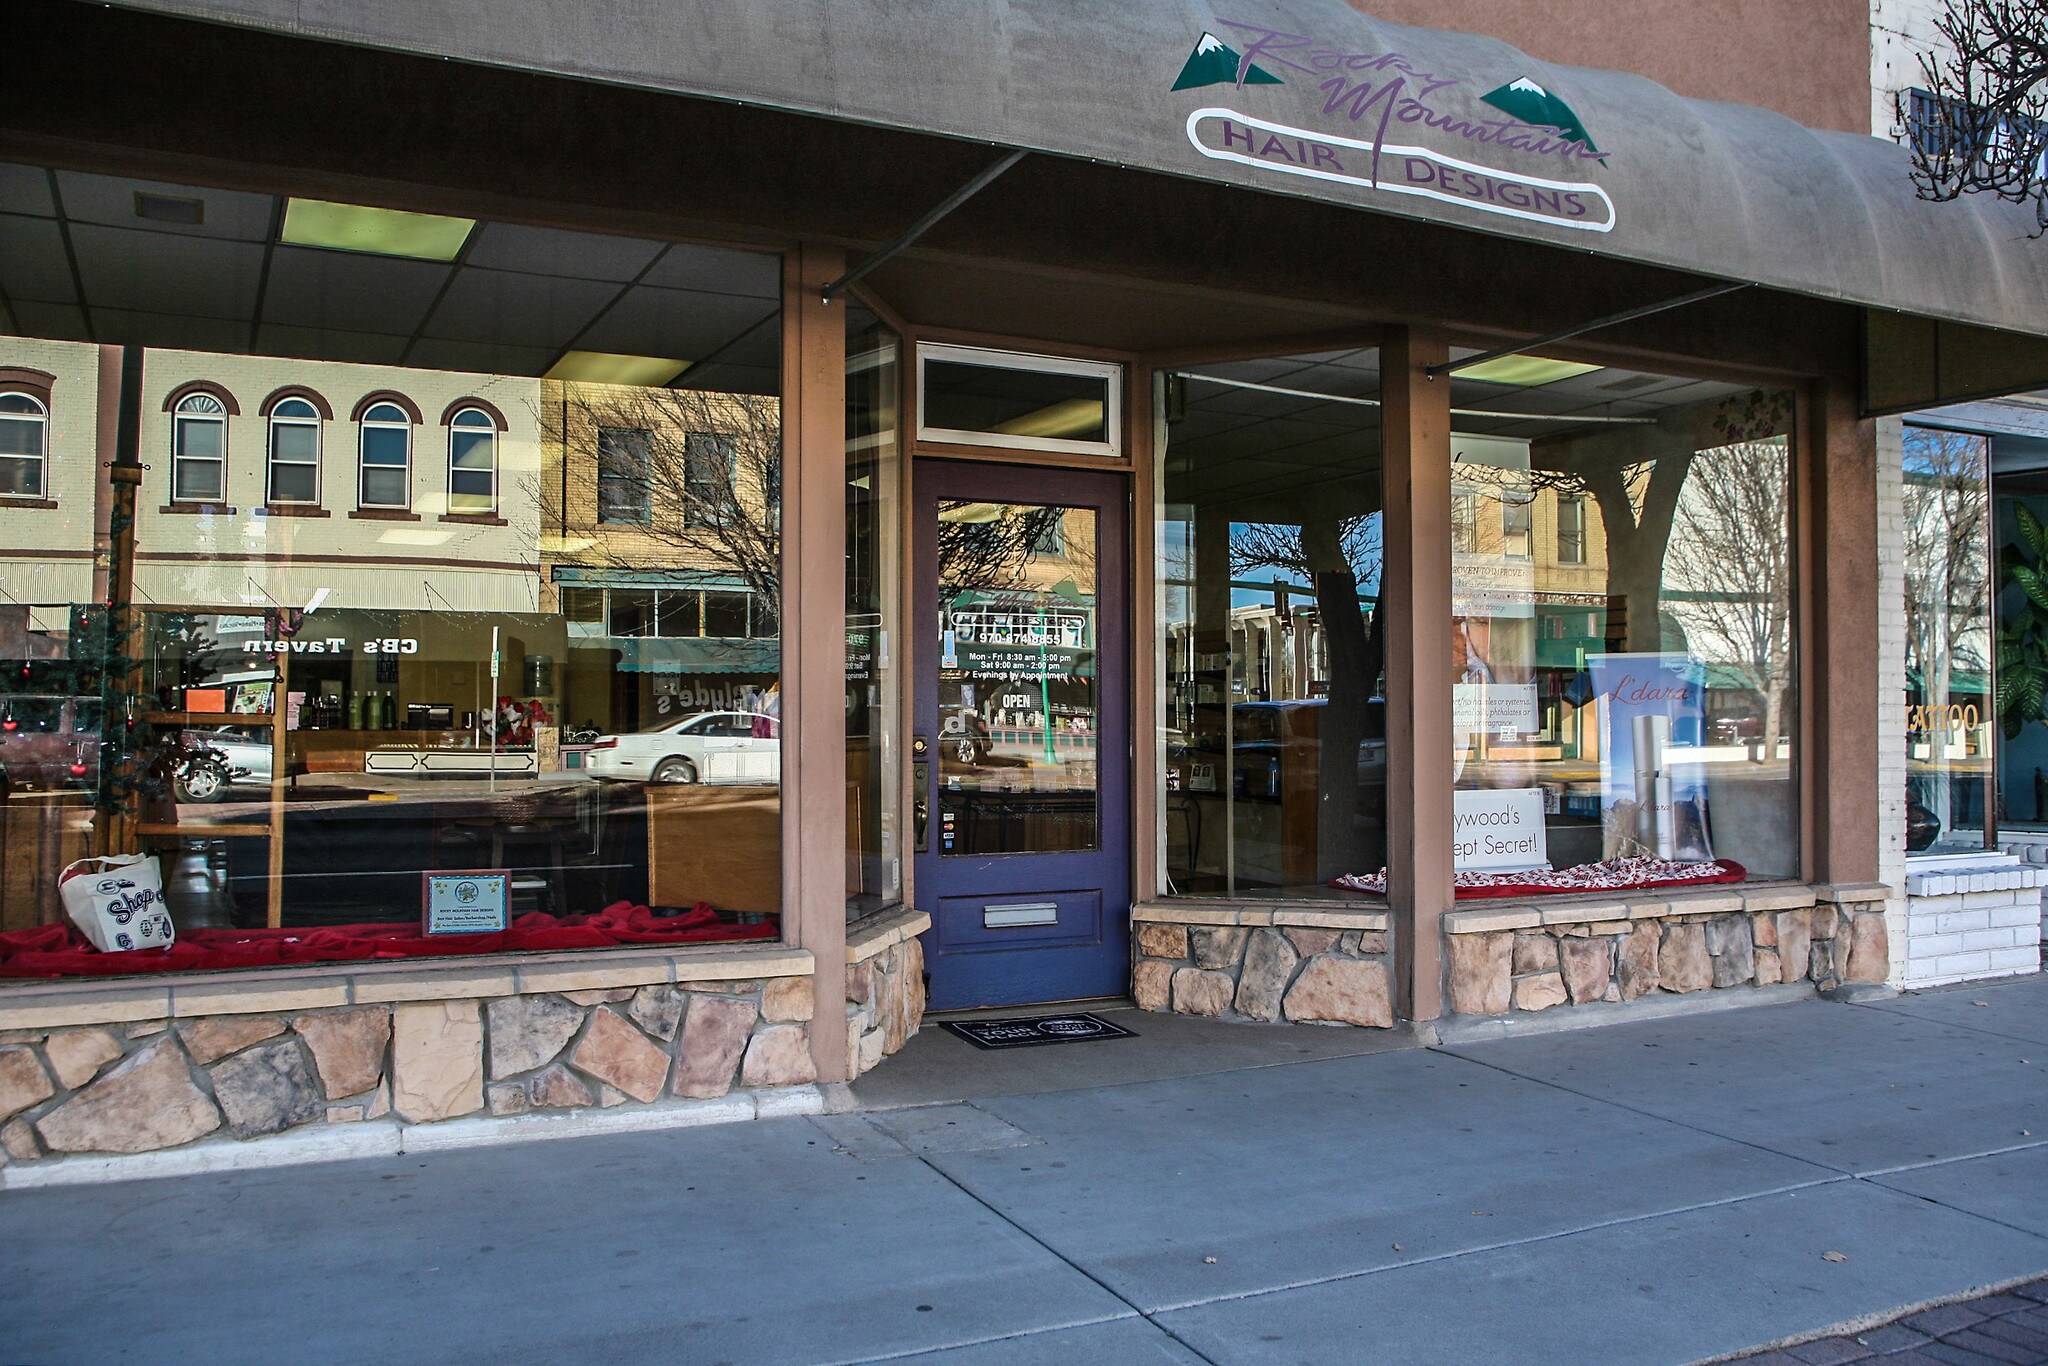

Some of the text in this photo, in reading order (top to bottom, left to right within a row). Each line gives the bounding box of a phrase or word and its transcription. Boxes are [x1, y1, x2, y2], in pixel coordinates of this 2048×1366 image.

[1215, 16, 1459, 99] Rocky
[1318, 74, 1613, 191] Mountain
[1223, 120, 1586, 218] HAIR DESIGNS
[1481, 566, 1491, 575] TO
[969, 652, 986, 661] Mon
[993, 652, 1003, 661] Fri
[1006, 653, 1023, 662] 8:30
[1042, 653, 1059, 662] 5:00
[1060, 655, 1072, 665] pm
[981, 661, 994, 669] Sat
[994, 661, 1011, 670] 9:00
[1030, 661, 1047, 670] 2:00
[1048, 663, 1060, 672] pm
[972, 671, 1008, 681] Evenings
[1009, 671, 1020, 682] by
[1020, 672, 1069, 681] Appointment
[1608, 674, 1689, 706] L'dara
[1002, 694, 1031, 708] OPEN
[1473, 696, 1497, 706] hales
[1454, 803, 1520, 833] ywood's
[1454, 833, 1537, 862] ept Secret!
[107, 888, 155, 925] Shop
